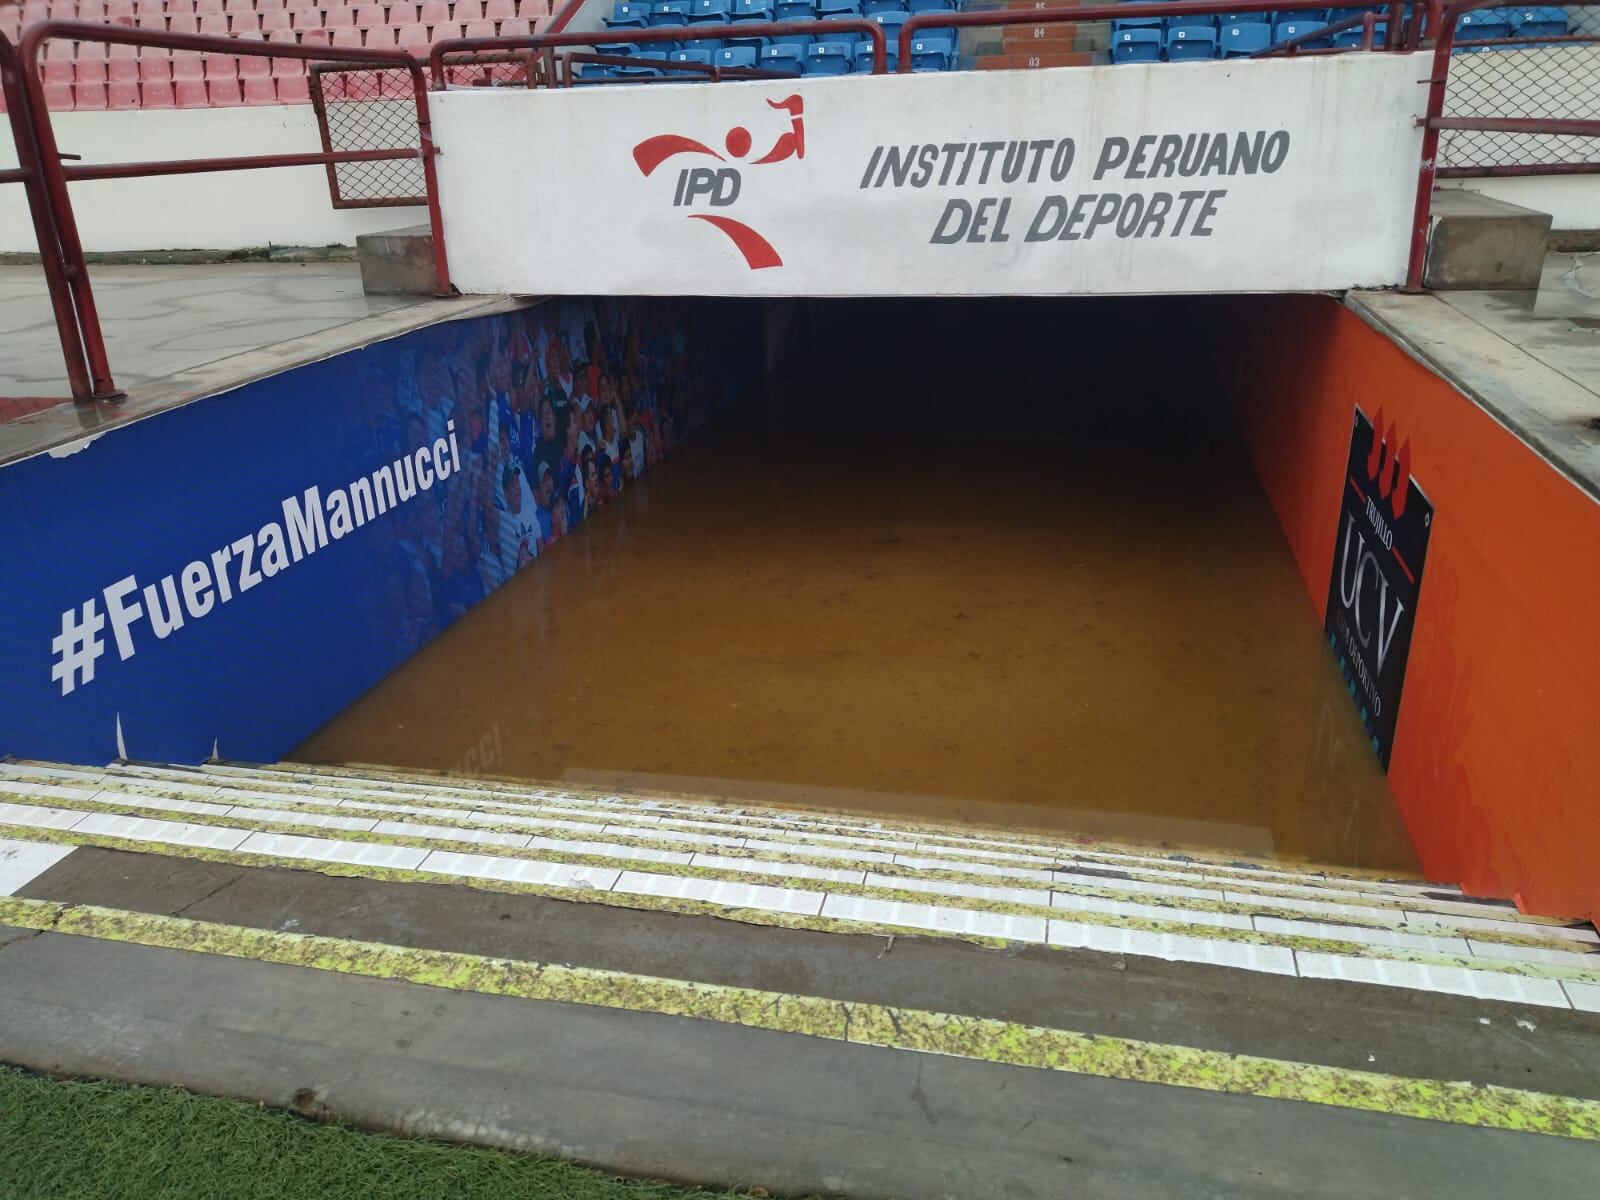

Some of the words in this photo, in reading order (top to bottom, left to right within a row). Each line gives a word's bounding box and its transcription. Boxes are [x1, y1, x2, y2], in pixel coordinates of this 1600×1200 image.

[1028, 57, 1040, 67] 03
[674, 168, 741, 206] IPD
[860, 138, 1075, 189] INSTITUTO
[1093, 131, 1289, 180] PERUANO
[929, 197, 1012, 244] DEL
[1024, 190, 1227, 242] DEPORTE
[1366, 496, 1393, 550] TRUJILLO
[51, 419, 461, 696] #FuerzaMannucci
[1340, 510, 1405, 677] UCV
[1349, 637, 1381, 717] DEPORTIVO
